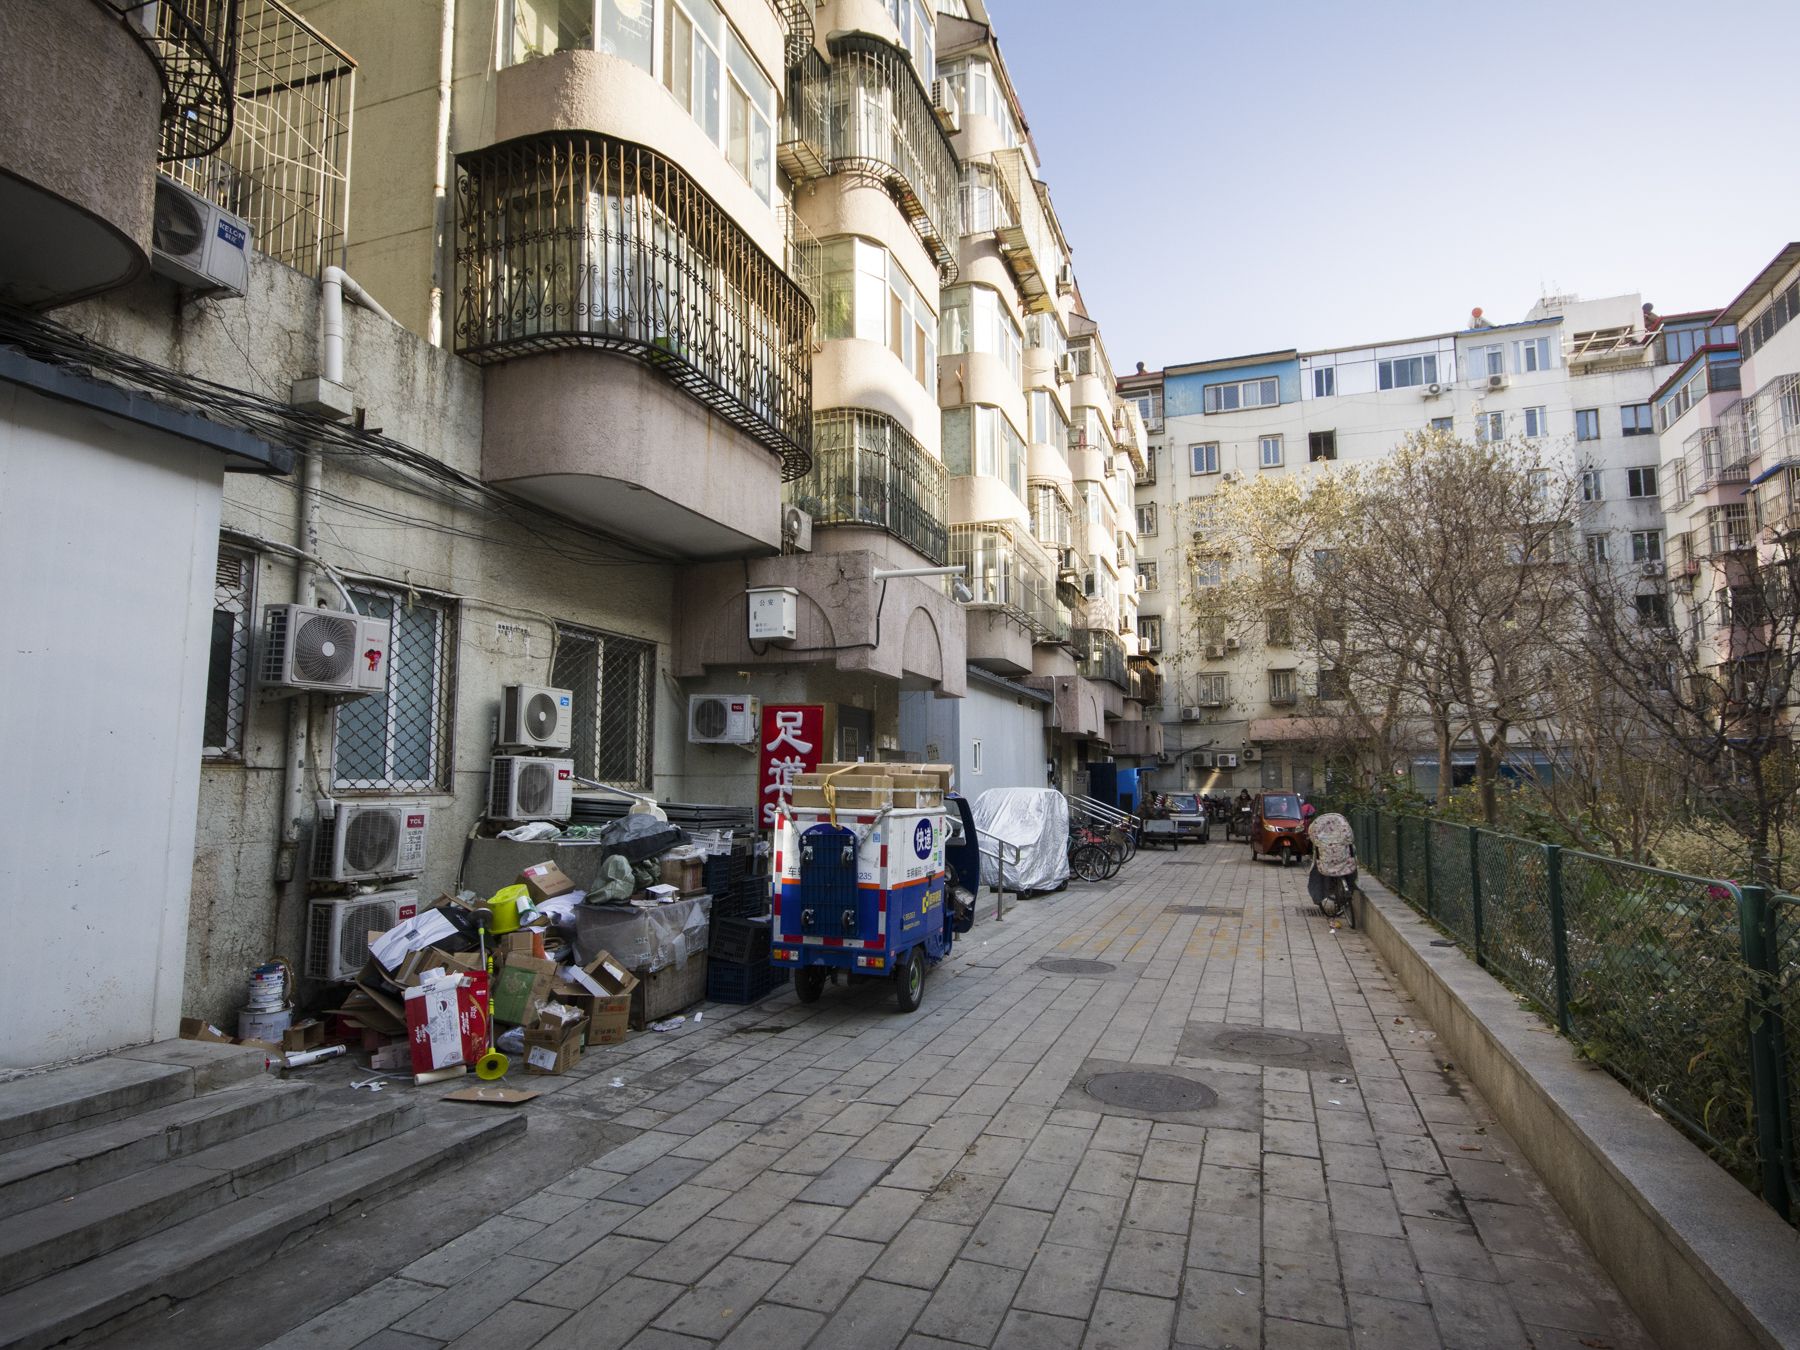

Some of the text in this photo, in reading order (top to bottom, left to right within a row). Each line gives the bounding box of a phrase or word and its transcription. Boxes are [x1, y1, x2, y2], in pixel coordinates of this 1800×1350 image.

[219, 221, 245, 241] KELON
[759, 598, 774, 607] 公安
[764, 711, 813, 796] 足道
[401, 909, 414, 917] TCL
